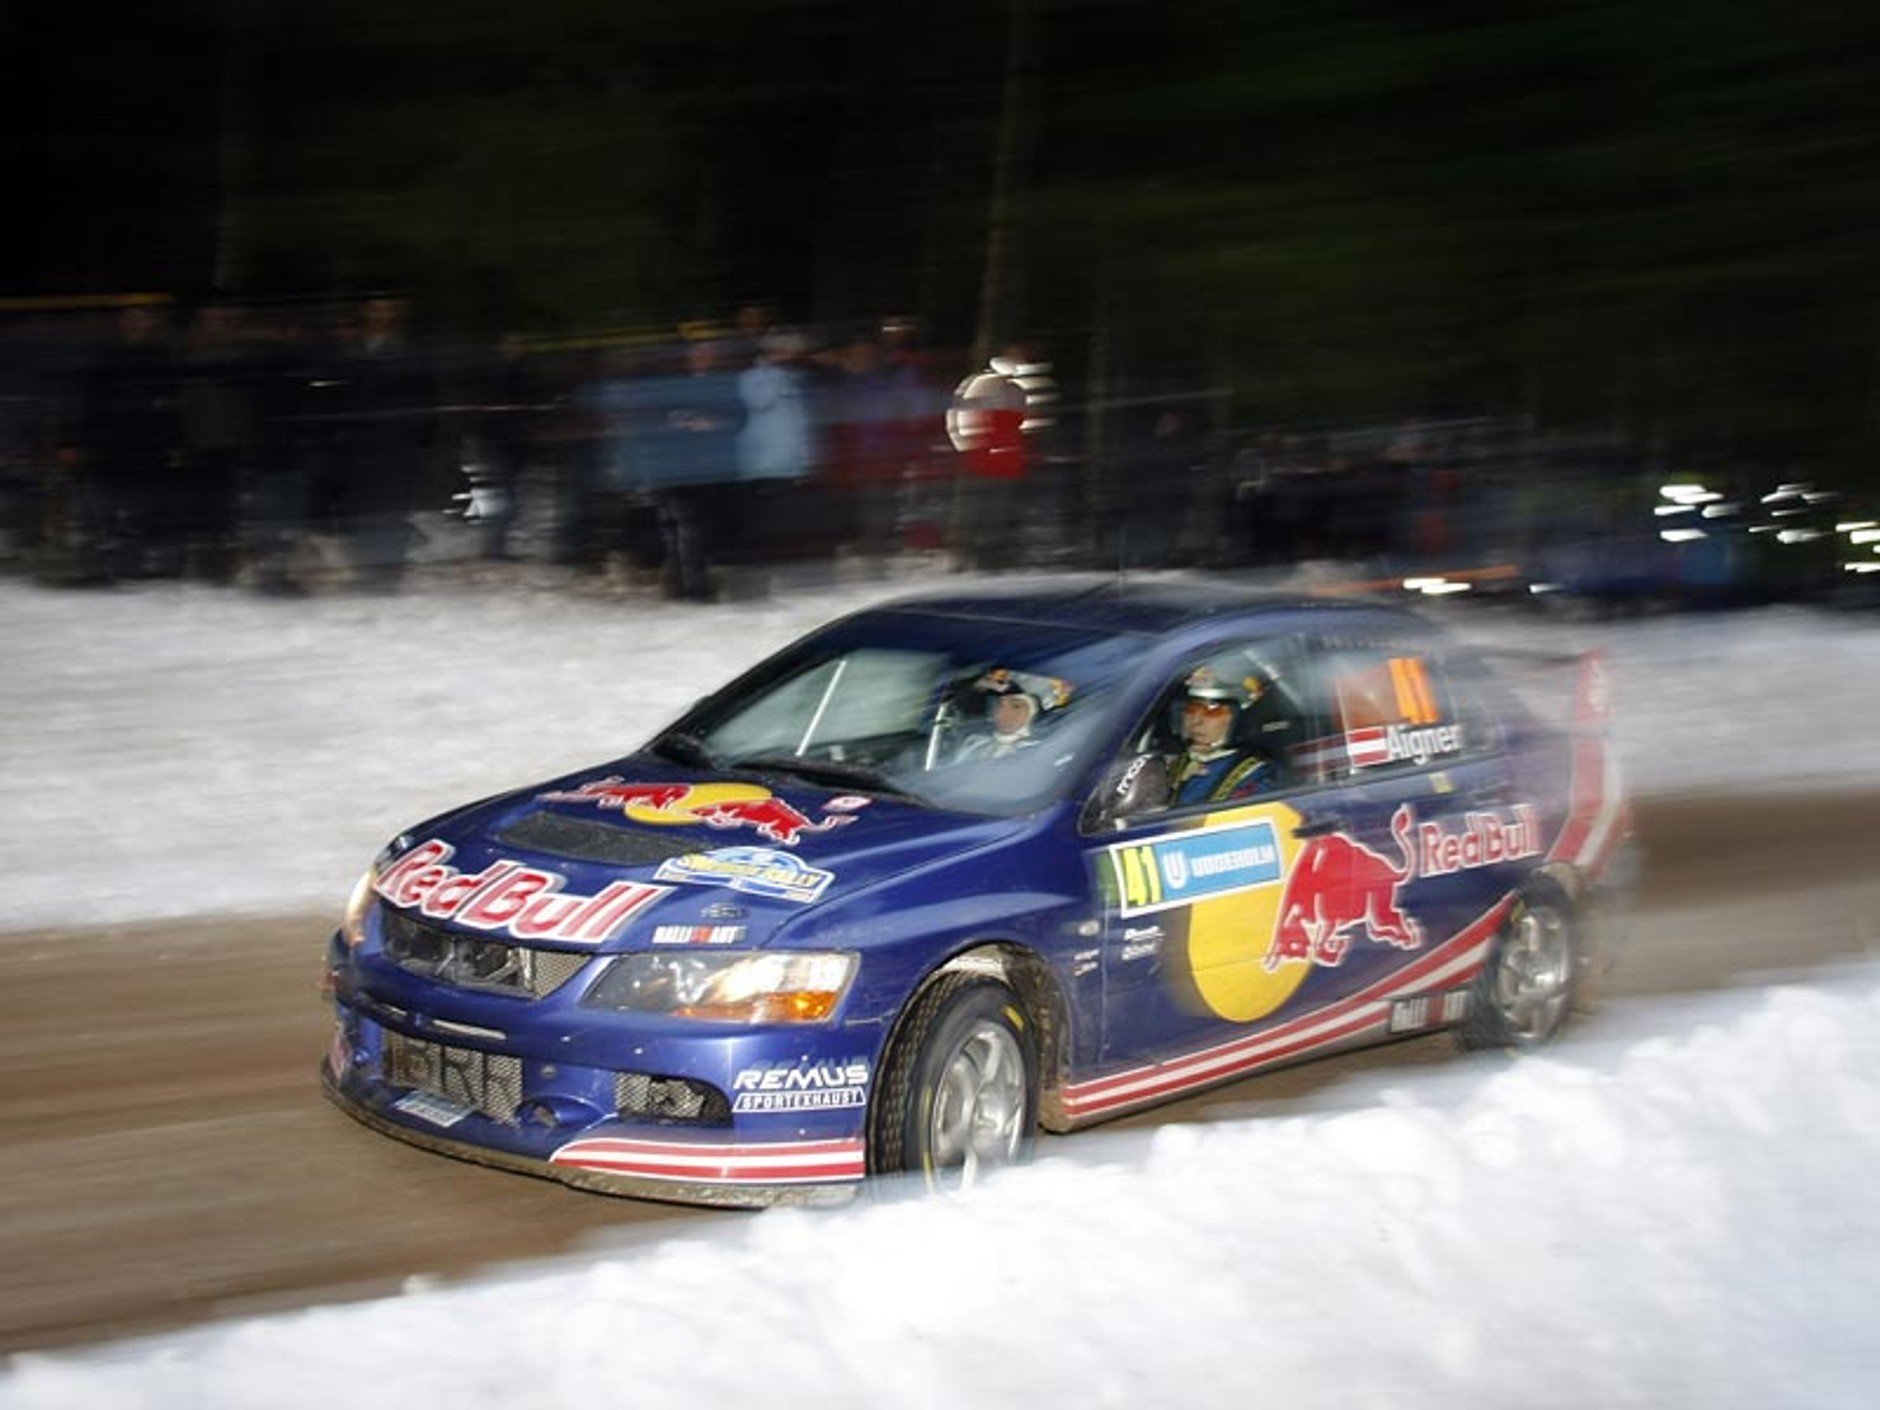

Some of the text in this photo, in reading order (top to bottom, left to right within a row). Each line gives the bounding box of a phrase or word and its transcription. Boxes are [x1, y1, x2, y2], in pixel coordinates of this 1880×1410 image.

[1387, 723, 1464, 766] Aigner
[1123, 845, 1162, 907] 41
[732, 1064, 869, 1090] REMUS
